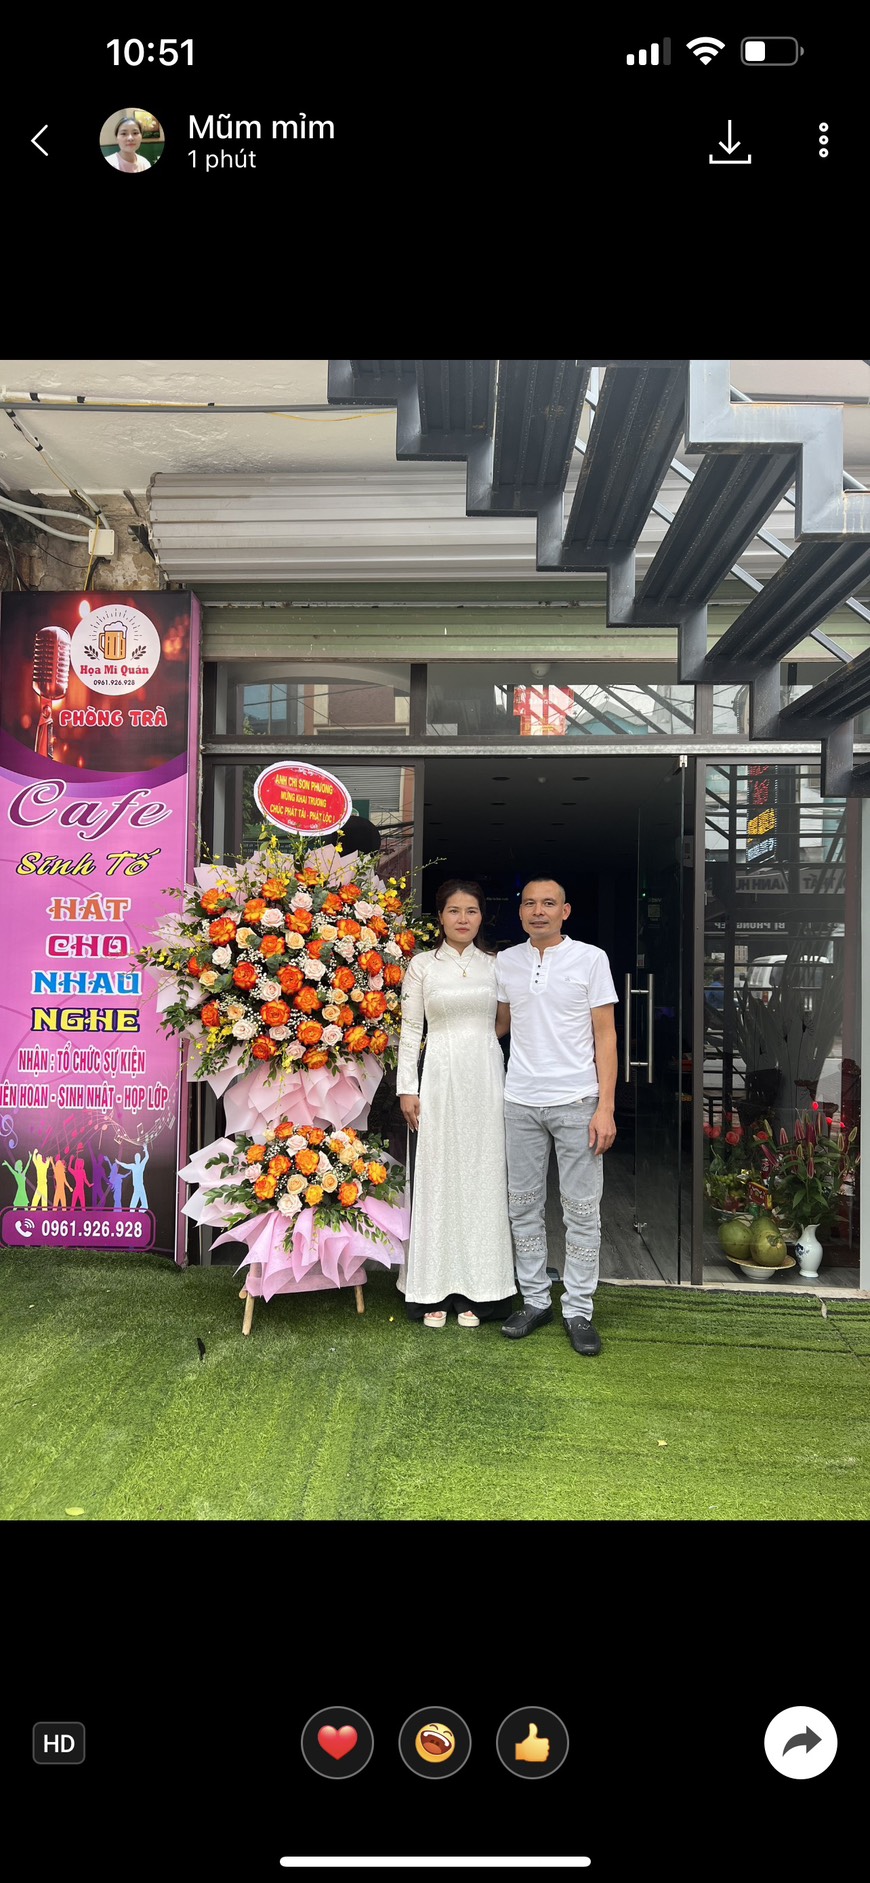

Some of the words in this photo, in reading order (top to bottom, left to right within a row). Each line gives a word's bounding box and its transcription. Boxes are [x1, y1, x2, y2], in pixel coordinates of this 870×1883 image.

[80, 665, 101, 676] Họa
[104, 665, 118, 674] Mi
[121, 665, 149, 676] Quán
[59, 706, 124, 727] PHÒNG
[128, 706, 168, 727] TRÀ
[275, 774, 288, 786] ANH
[288, 776, 298, 790] CHỊ
[311, 781, 334, 795] PHƯƠNG
[8, 778, 172, 841] Cafe
[281, 790, 295, 802] MỪNG
[296, 792, 308, 804] KHAI
[308, 796, 327, 808] TRƯƠNG
[270, 802, 284, 814] CHÚC
[285, 805, 297, 816] PHÁT
[297, 807, 306, 818] TÀI
[310, 809, 322, 821] PHÁT
[323, 812, 332, 825] LỘC
[106, 848, 162, 876] Tố
[46, 892, 131, 922] HÁT
[46, 933, 131, 959] CHO
[31, 970, 142, 995] NHAU
[31, 1006, 140, 1032] NGHE
[18, 1044, 48, 1077] NHẬN
[56, 1041, 72, 1073] TỔ
[72, 1045, 102, 1074] CHỨC
[103, 1046, 120, 1078] SỰ
[120, 1045, 146, 1078] KIỆN
[0, 1080, 17, 1108] IÊN
[19, 1084, 50, 1108] HOAN
[58, 1085, 85, 1109] SINH
[86, 1081, 115, 1114] NHẬT
[123, 1084, 146, 1115] HỌP
[148, 1081, 169, 1110] LỚP
[41, 1219, 143, 1239] 0961.926.928
